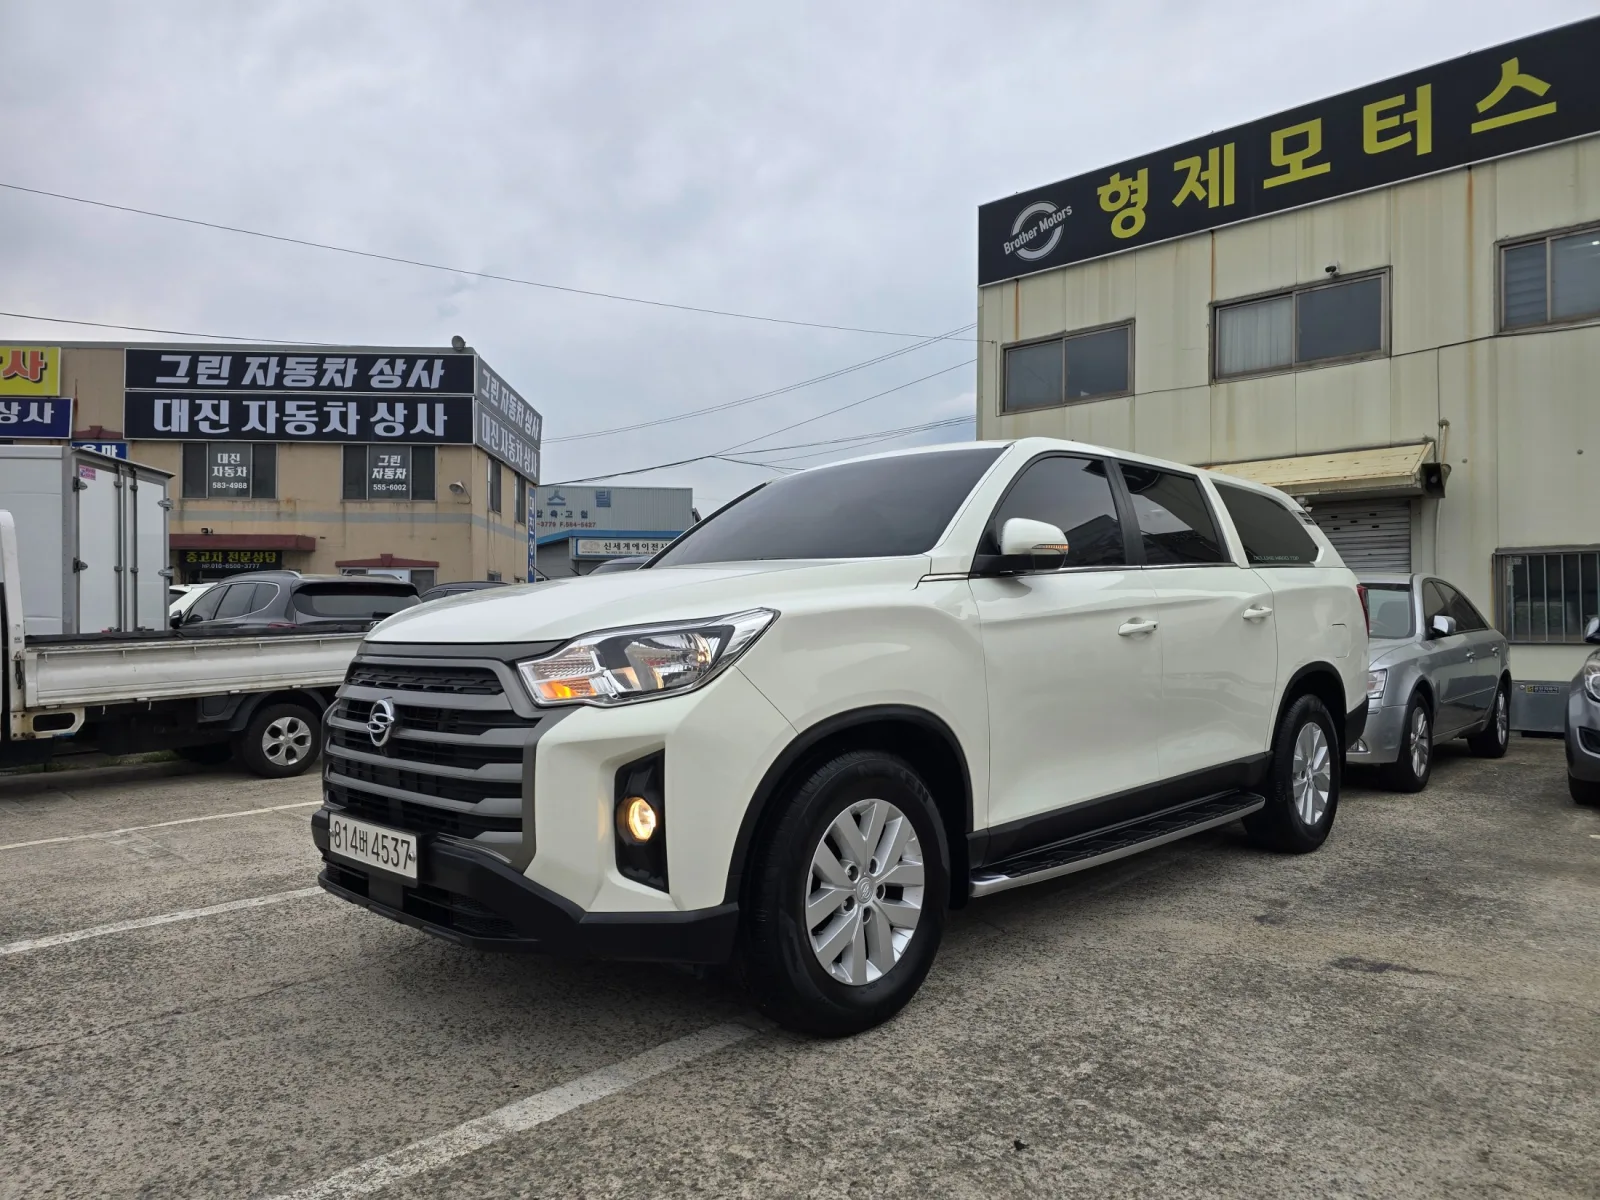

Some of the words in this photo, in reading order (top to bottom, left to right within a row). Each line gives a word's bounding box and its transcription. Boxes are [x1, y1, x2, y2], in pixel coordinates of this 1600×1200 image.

[1003, 226, 1038, 255] Brother
[1039, 205, 1073, 233] Motors
[0, 349, 45, 381] 사
[155, 354, 233, 386] 그린
[241, 355, 358, 388] 자동차
[368, 358, 446, 390] 상사
[153, 398, 230, 434] 대진
[241, 400, 360, 435] 자동차
[369, 402, 448, 438] 상사
[481, 368, 500, 408] 그린
[500, 386, 525, 428] 자동차
[524, 408, 540, 441] 상사
[217, 453, 241, 464] 대진
[378, 455, 402, 466] 그린
[482, 412, 499, 451] 대진
[500, 427, 523, 468] 자동차
[524, 446, 537, 478] 상사
[211, 466, 247, 477] 자동차
[371, 467, 407, 480] 자동차
[186, 551, 223, 563] 중고차
